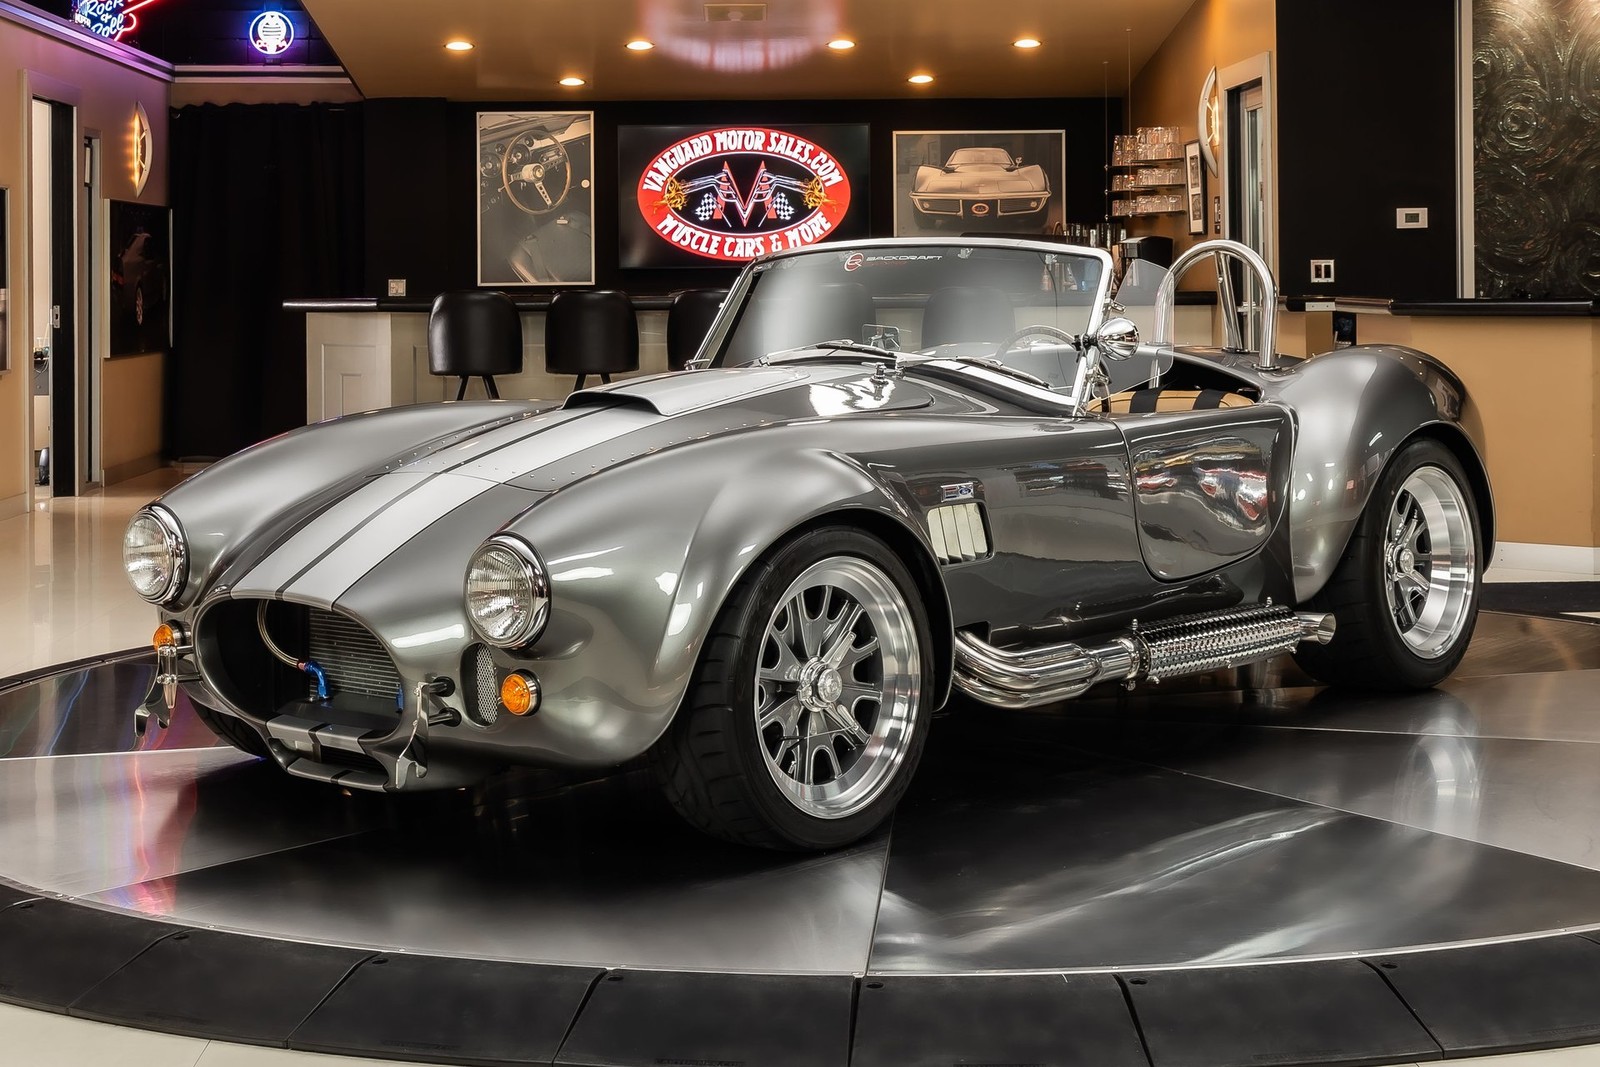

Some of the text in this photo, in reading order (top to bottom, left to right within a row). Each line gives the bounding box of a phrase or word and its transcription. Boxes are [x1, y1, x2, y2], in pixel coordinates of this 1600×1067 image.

[642, 130, 844, 192] VANGUARD MOTOR SALES.COM
[656, 211, 832, 258] MUSCLE CARS & MORE
[866, 254, 943, 262] BACKDRAFT
